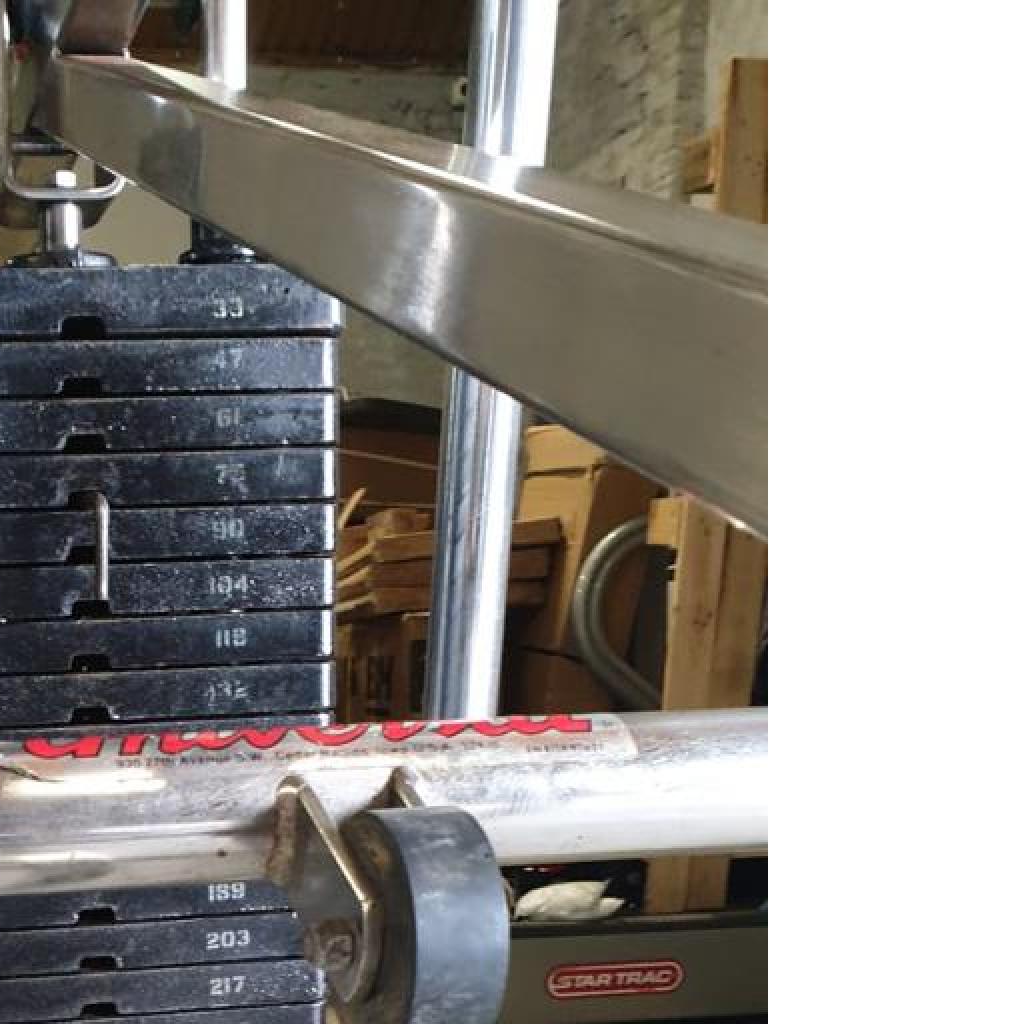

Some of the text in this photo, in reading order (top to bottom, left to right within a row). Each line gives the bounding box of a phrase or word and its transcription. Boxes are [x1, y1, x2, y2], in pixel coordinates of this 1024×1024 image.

[215, 348, 243, 368] 47
[217, 408, 241, 428] 61
[212, 519, 244, 539] 90
[215, 628, 247, 648] 118
[207, 929, 250, 950] 203
[210, 976, 245, 995] 217
[553, 970, 673, 988] STAR TRAC
